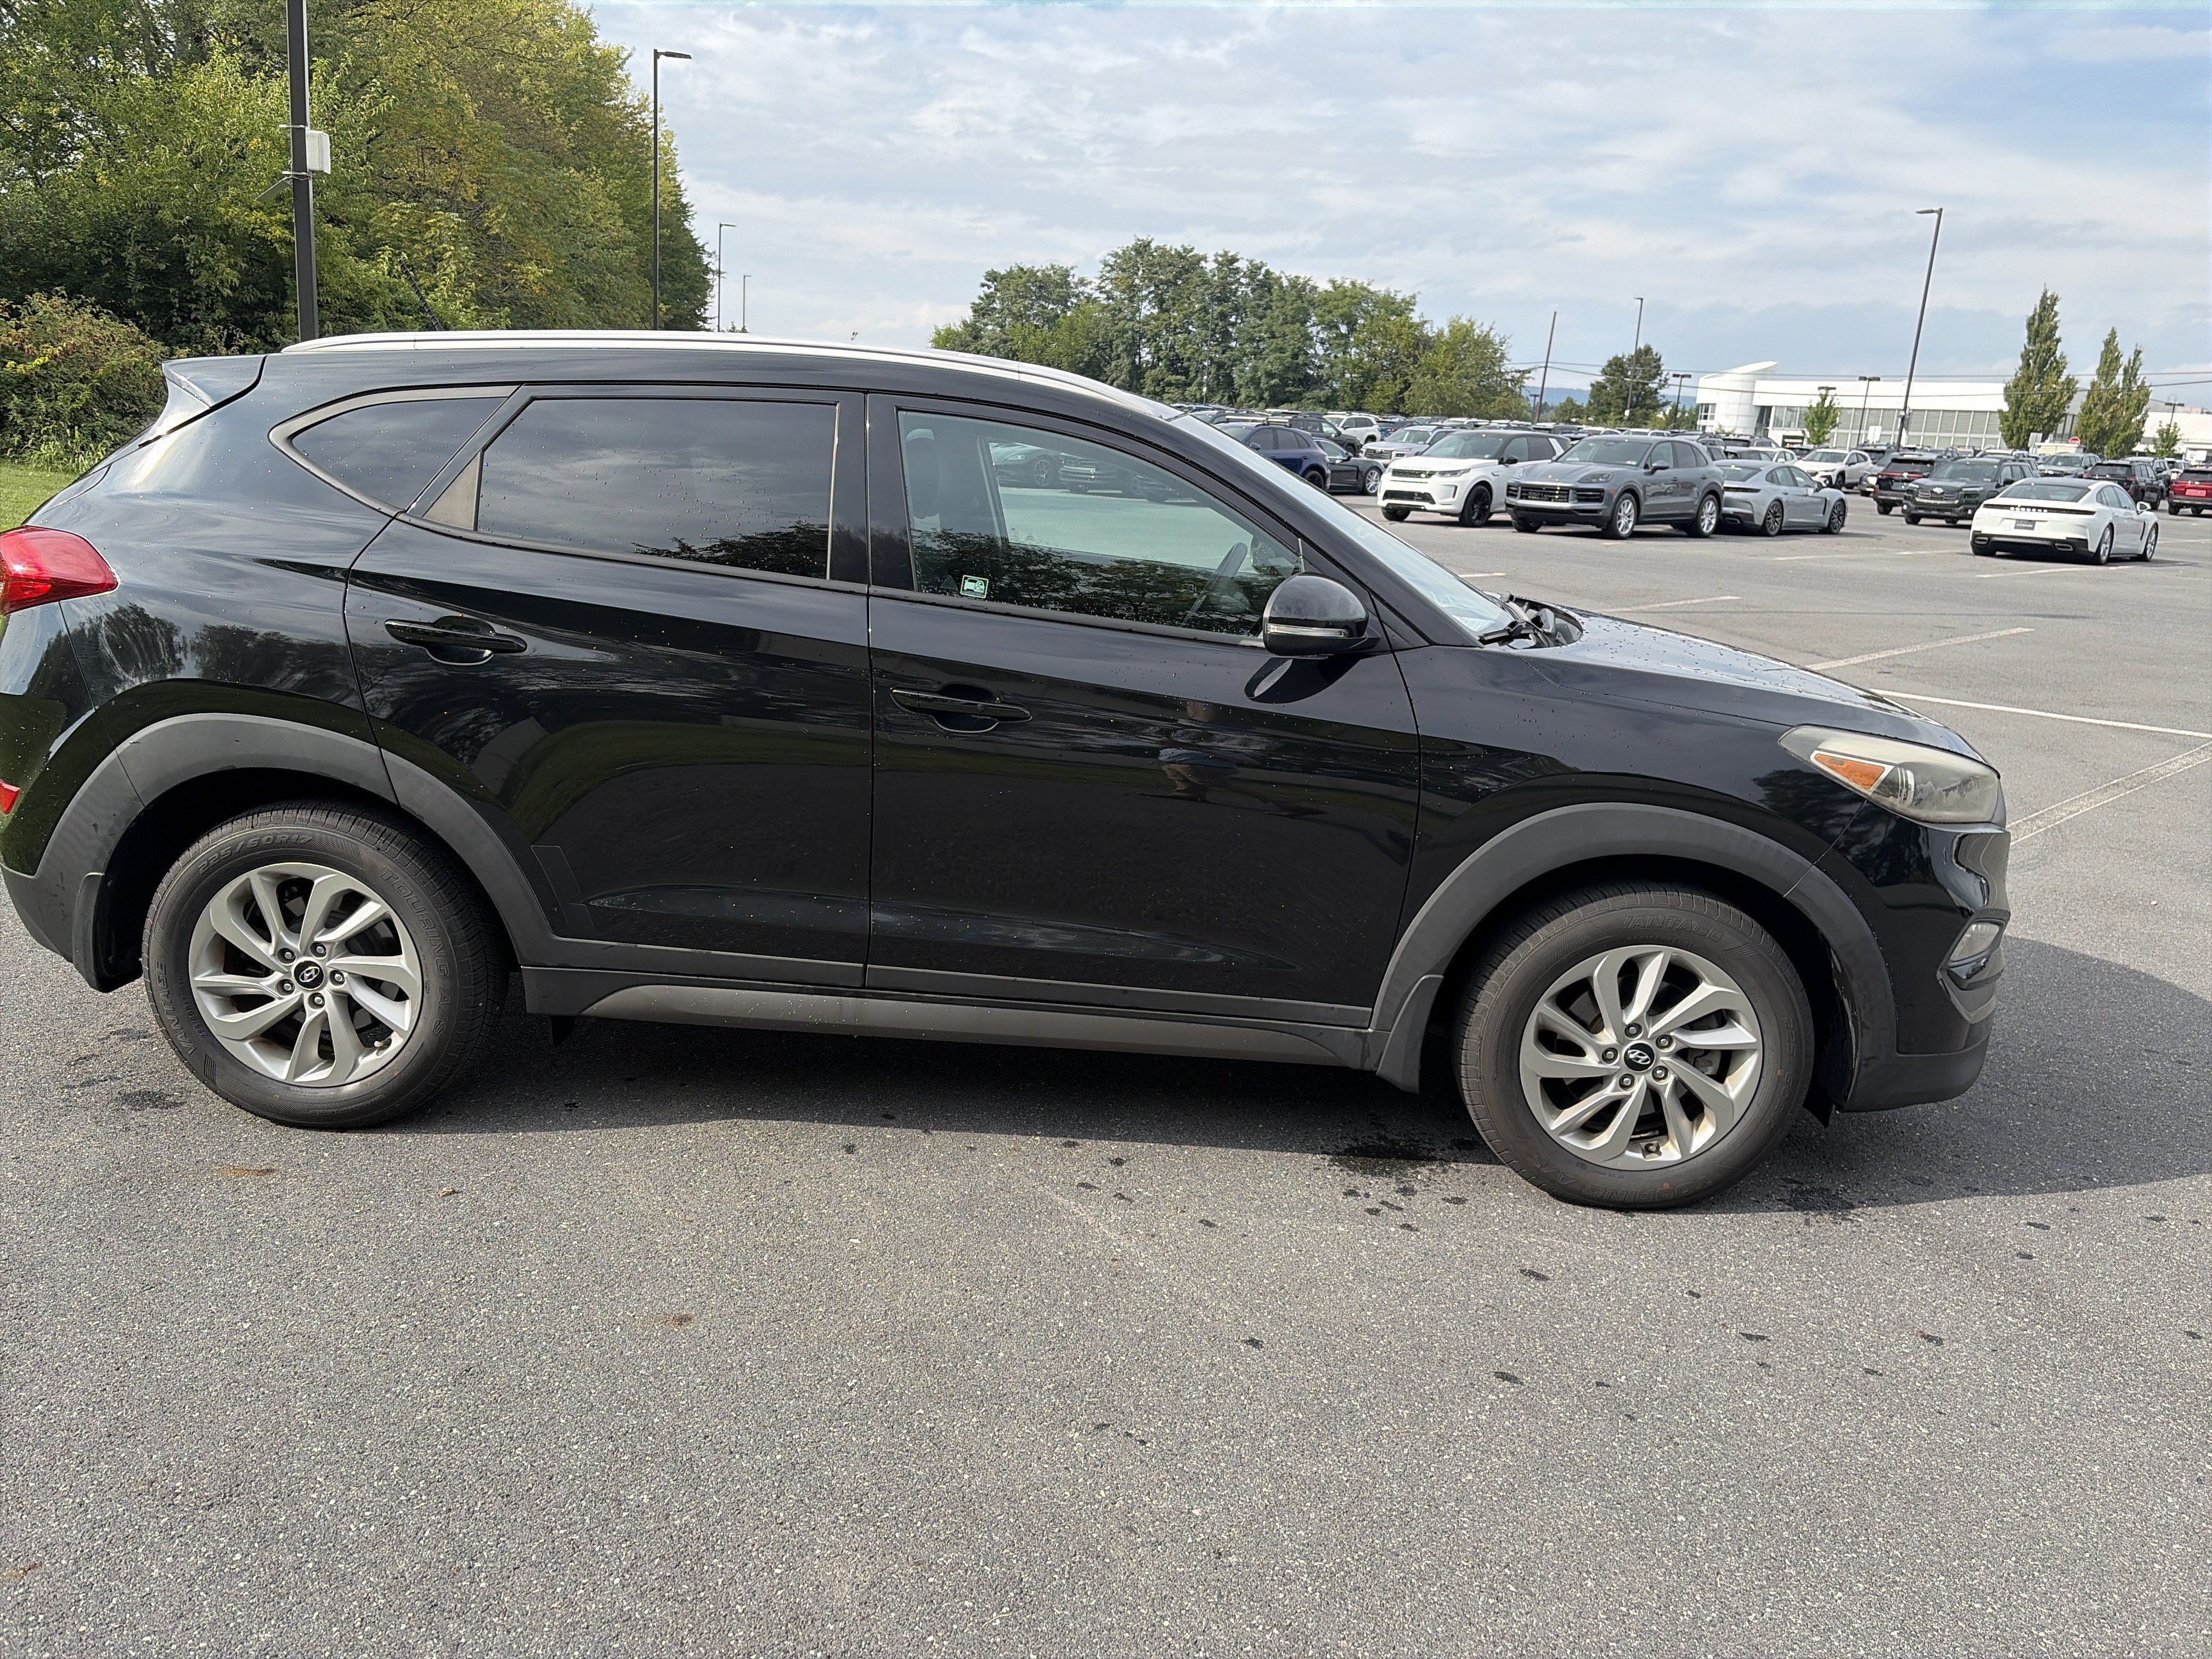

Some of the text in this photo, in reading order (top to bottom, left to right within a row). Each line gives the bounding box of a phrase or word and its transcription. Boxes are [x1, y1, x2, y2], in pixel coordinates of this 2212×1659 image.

[198, 834, 313, 876] 225/60R17
[1617, 915, 1725, 943] VANTAGE
[380, 866, 452, 1036] TOURING A/S
[154, 960, 196, 1056] VANTAGE
[1527, 1153, 1579, 1185] A/S
[1582, 1176, 1713, 1203] TOURING
